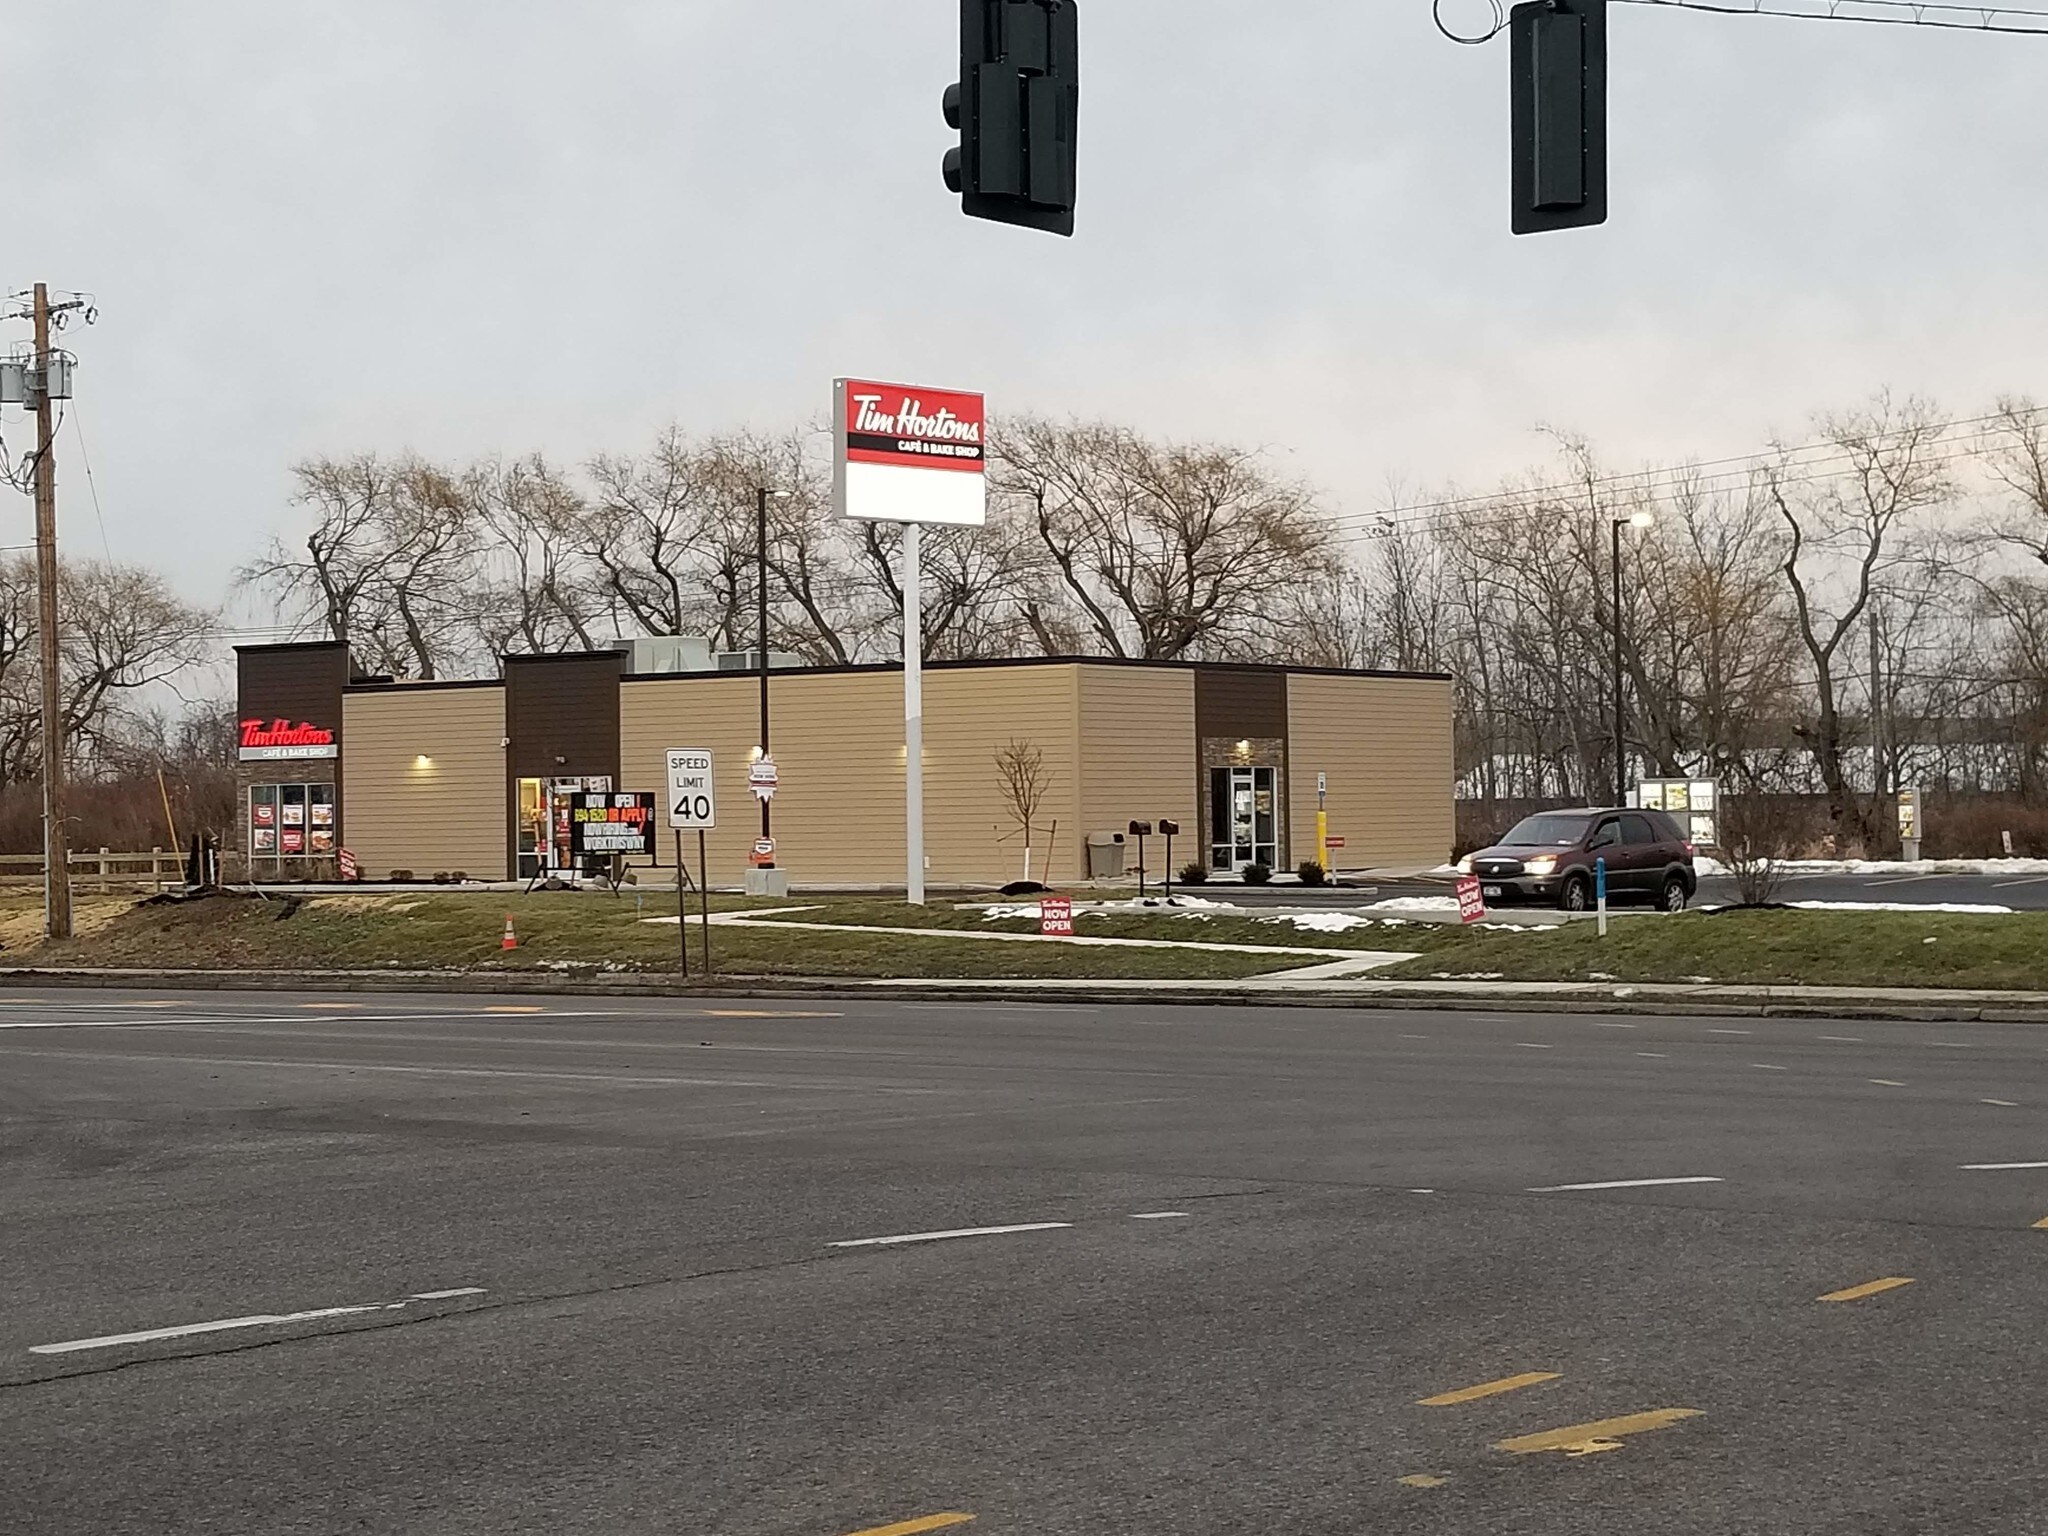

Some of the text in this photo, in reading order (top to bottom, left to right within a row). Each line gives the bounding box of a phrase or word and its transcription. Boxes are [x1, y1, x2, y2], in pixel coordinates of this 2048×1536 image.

[853, 395, 979, 441] Tim Hortons
[931, 444, 954, 455] BAKE
[955, 446, 980, 457] SHOP
[240, 718, 334, 746] Tim Hortons
[671, 758, 709, 769] SPEED
[676, 777, 704, 788] LIMIT
[585, 794, 606, 808] NOW
[674, 795, 710, 820] 40
[620, 808, 647, 822] APPLY
[1459, 889, 1479, 905] NOW
[1044, 909, 1069, 919] NOW
[1461, 901, 1483, 917] OPEN
[1043, 920, 1071, 931] OPEN
